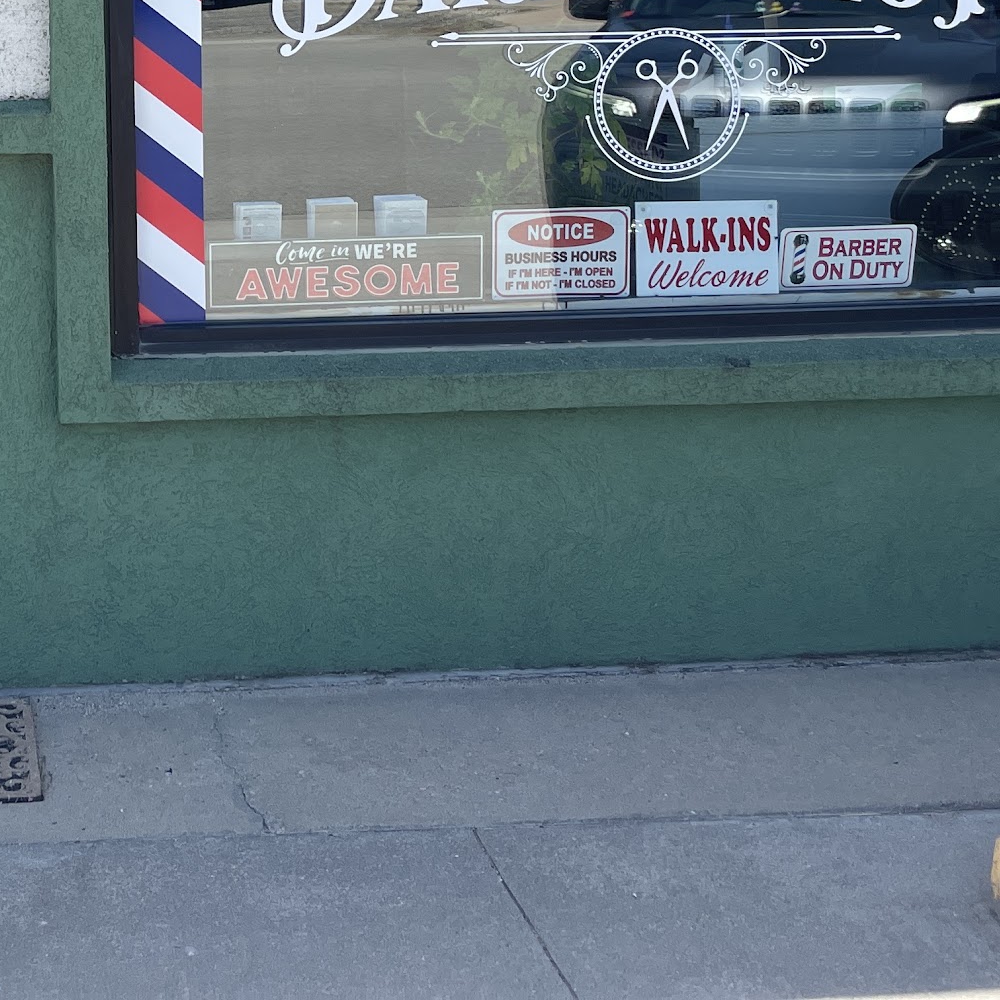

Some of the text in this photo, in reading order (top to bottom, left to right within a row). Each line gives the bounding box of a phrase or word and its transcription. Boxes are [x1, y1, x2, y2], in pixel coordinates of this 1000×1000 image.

[527, 222, 594, 241] NOTICE
[644, 216, 771, 253] WALK-INS
[275, 240, 417, 265] Come in WE'RE
[505, 251, 617, 265] BUSINESS HOURS
[818, 237, 901, 258] BARBER
[508, 269, 517, 278] IF
[519, 268, 532, 278] I'M
[534, 268, 561, 277] HERE
[569, 267, 583, 277] I'M
[585, 267, 613, 277] OPEN
[648, 259, 769, 290] Welcome
[812, 260, 904, 281] ON DUTY
[236, 262, 460, 301] AWESOME
[505, 281, 514, 290] IF
[516, 280, 529, 290] I'M
[531, 280, 551, 290] NOT
[559, 280, 573, 289] I'M
[575, 279, 616, 289] CLOSED
